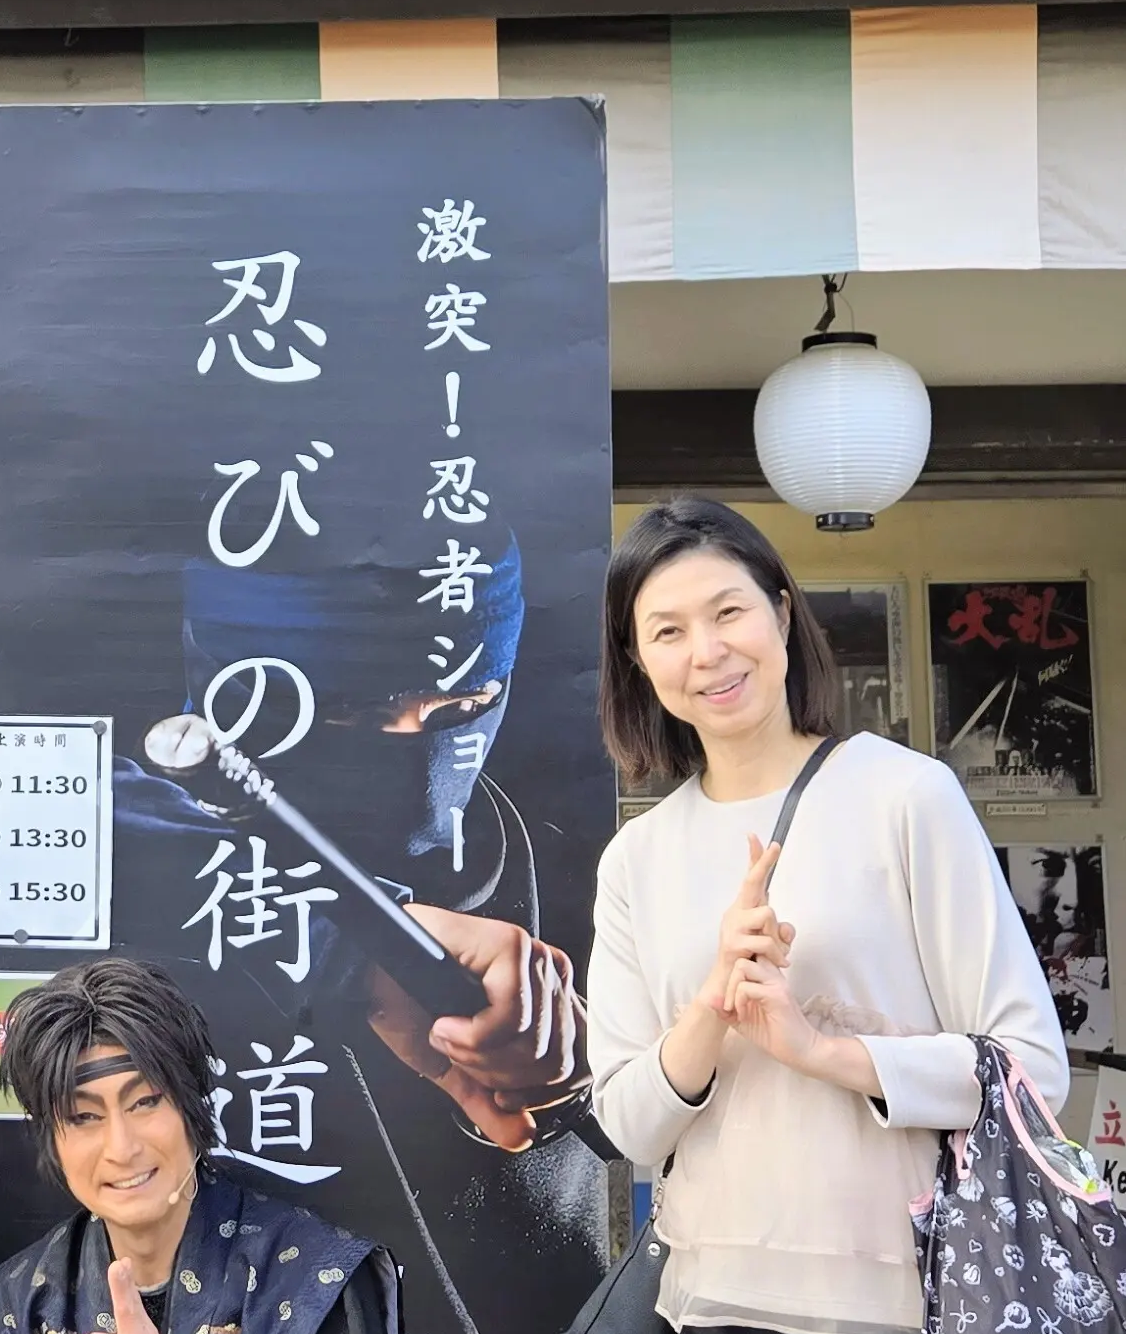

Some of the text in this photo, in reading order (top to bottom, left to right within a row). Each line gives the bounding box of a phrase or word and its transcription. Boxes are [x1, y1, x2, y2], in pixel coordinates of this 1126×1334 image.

[181, 250, 342, 1185] 忍びの街道
[11, 776, 88, 794] 11:30
[9, 829, 87, 848] 13:30
[9, 882, 86, 902] 15:30
